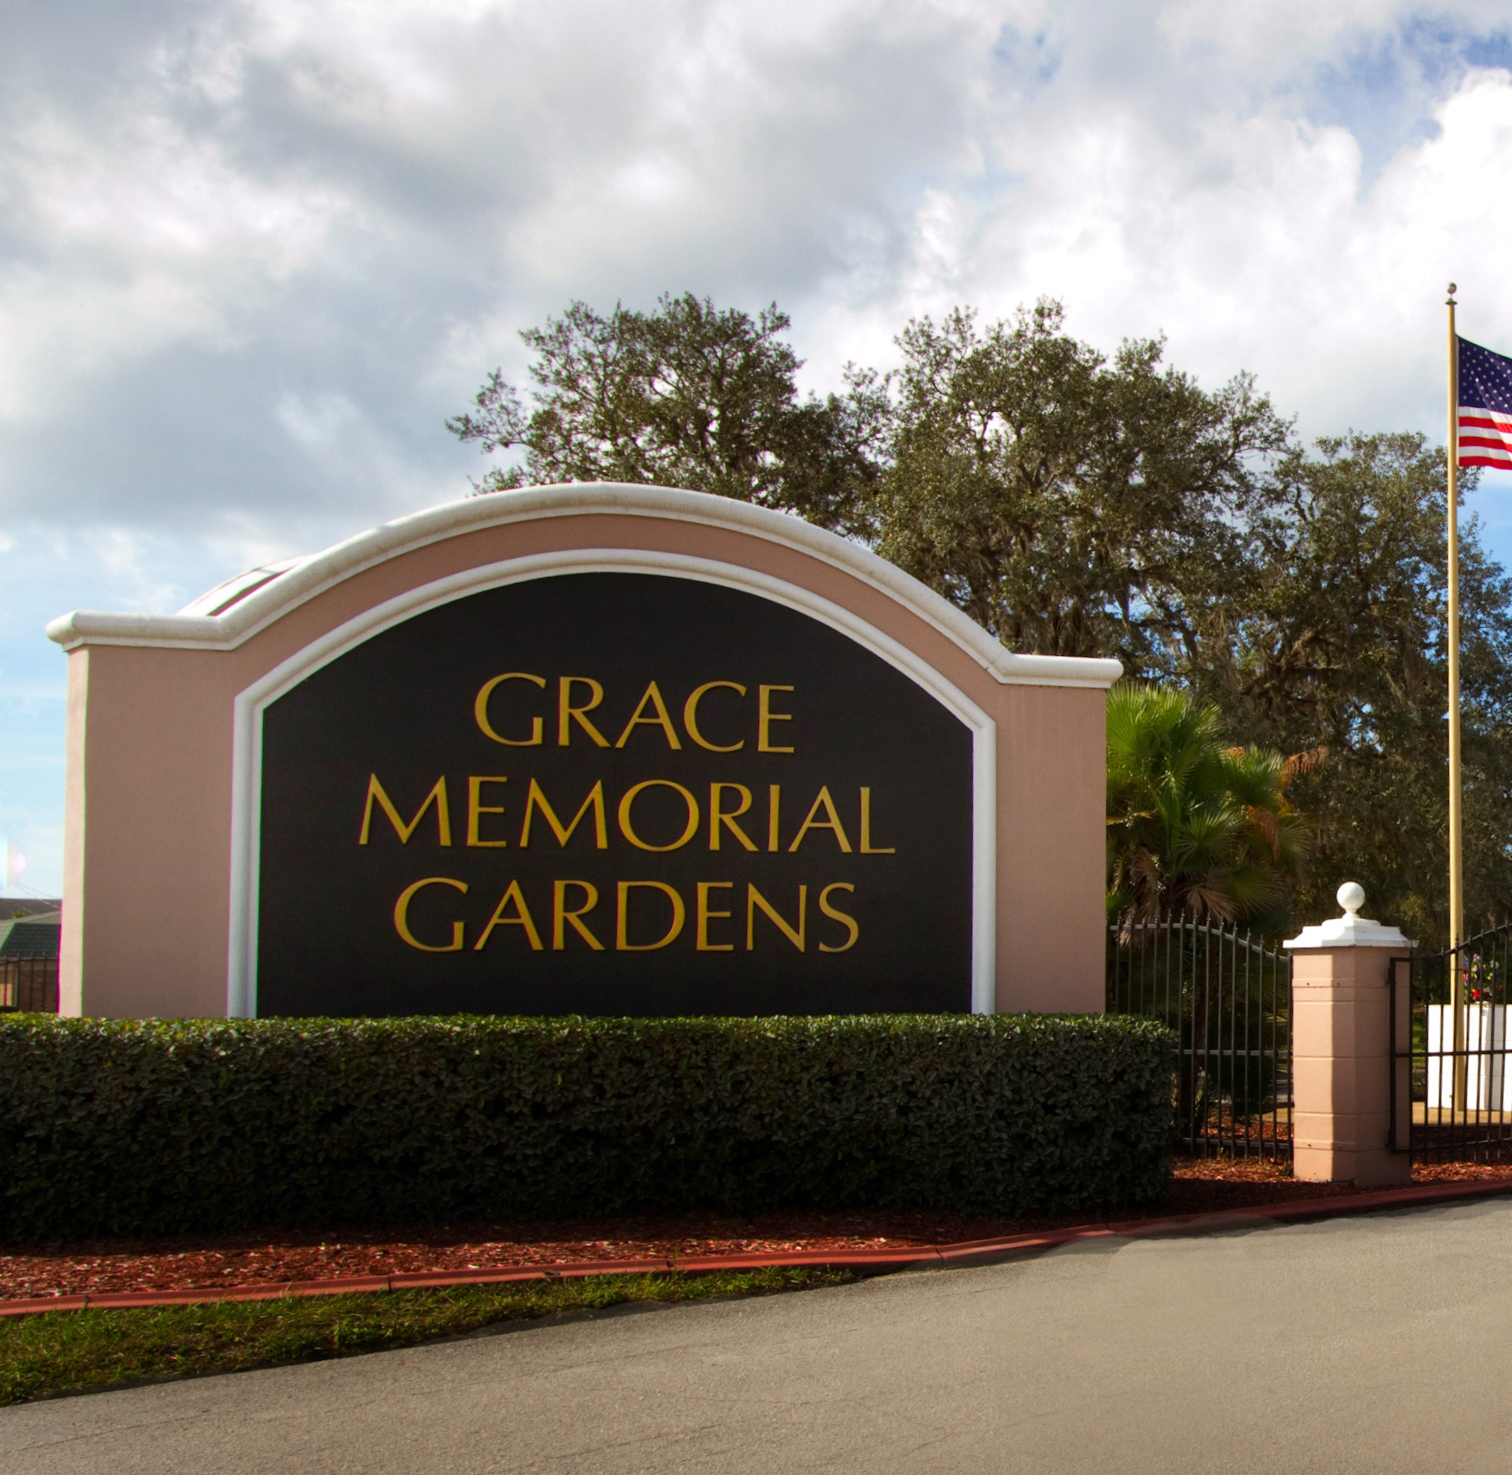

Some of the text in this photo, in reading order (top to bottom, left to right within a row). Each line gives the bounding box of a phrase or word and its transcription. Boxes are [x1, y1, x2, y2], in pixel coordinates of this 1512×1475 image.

[474, 672, 796, 753] GRACE
[358, 773, 896, 854] MEMORIAL
[394, 878, 860, 953] GARDENS
